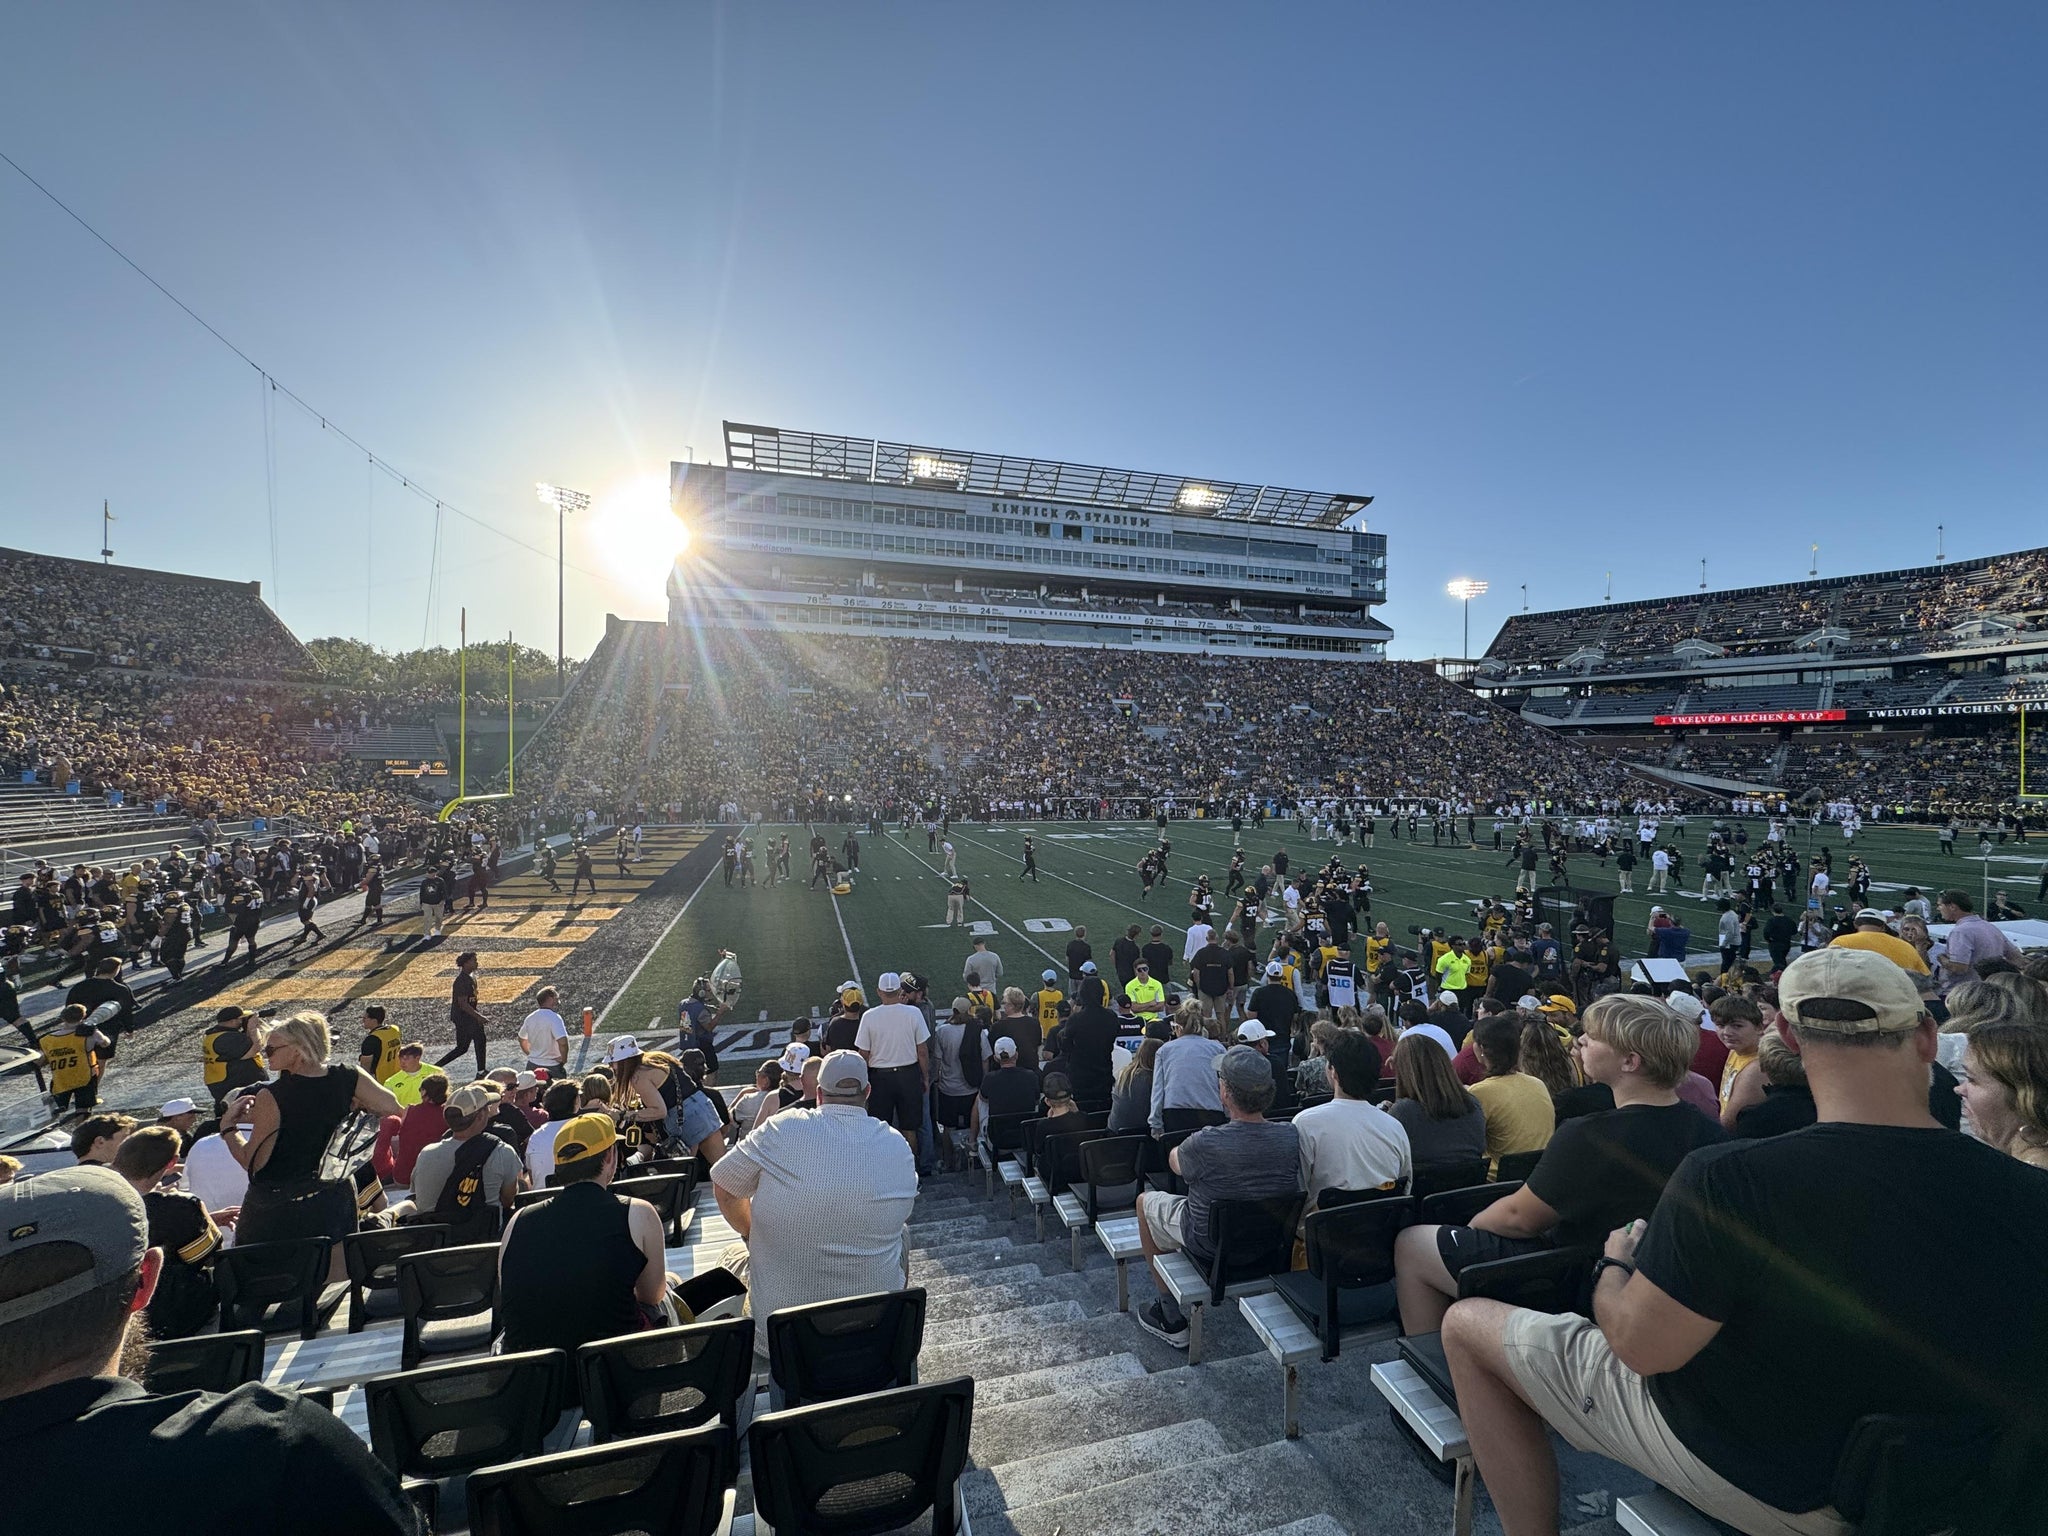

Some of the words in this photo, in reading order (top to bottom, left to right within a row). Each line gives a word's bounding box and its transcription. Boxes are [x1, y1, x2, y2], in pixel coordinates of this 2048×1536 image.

[992, 503, 1058, 518] KINNICK
[1085, 512, 1150, 527] STADIUM
[1305, 587, 1333, 595] Mediacom
[843, 598, 855, 606] 36
[881, 601, 892, 609] 25
[948, 605, 958, 613] 15
[980, 607, 991, 615] 24
[1867, 708, 1933, 718] TWELVE01
[1937, 704, 2003, 715] KITCHEN
[2007, 703, 2018, 712] &
[1671, 715, 1726, 724] TWELVE01
[1730, 713, 1784, 723] KITCHEN
[1787, 713, 1796, 721] &
[1799, 712, 1823, 720] TAP
[1746, 866, 1762, 876] 26
